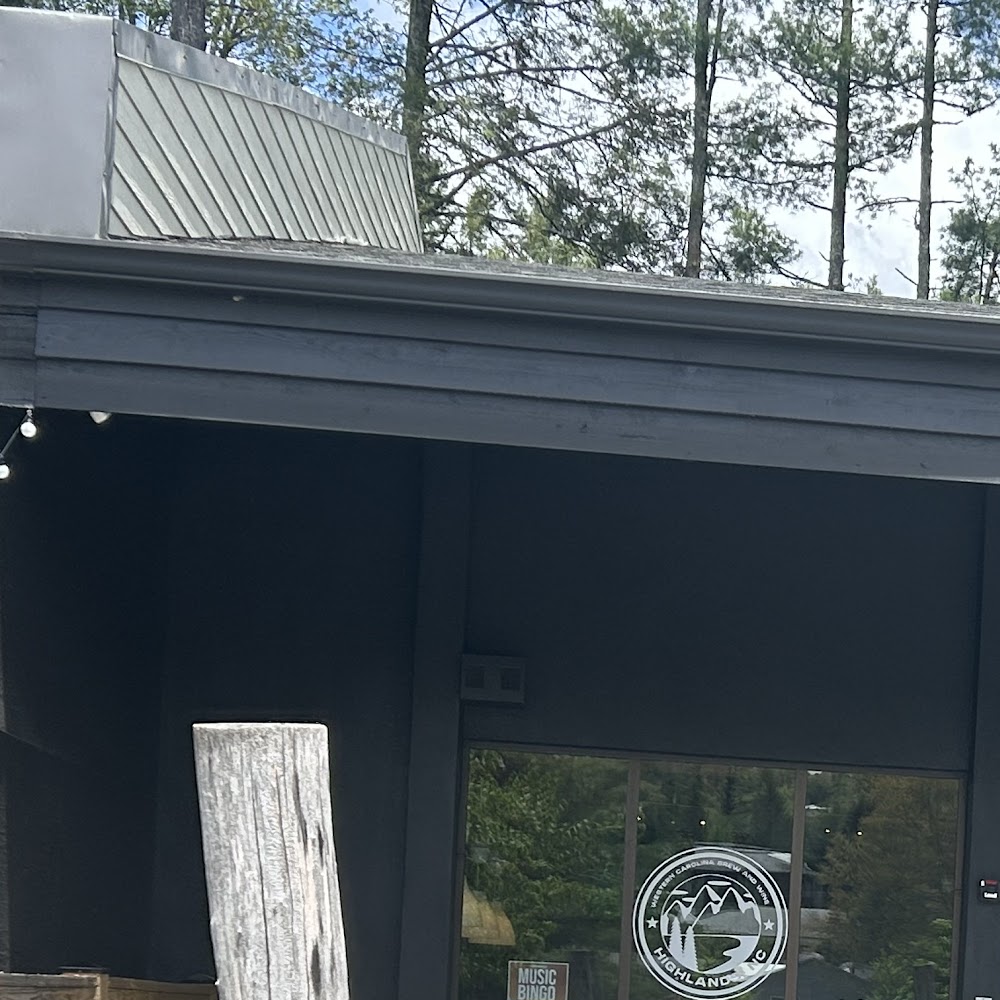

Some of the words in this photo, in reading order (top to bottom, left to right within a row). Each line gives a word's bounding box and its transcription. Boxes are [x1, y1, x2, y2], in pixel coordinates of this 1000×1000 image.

[650, 873, 676, 908] WESTERN
[675, 860, 715, 875] CAROLINA
[716, 860, 741, 873] BREW
[741, 870, 758, 885] AND
[756, 883, 770, 905] WINE
[746, 949, 767, 971] NC
[518, 967, 557, 985] MUSIC
